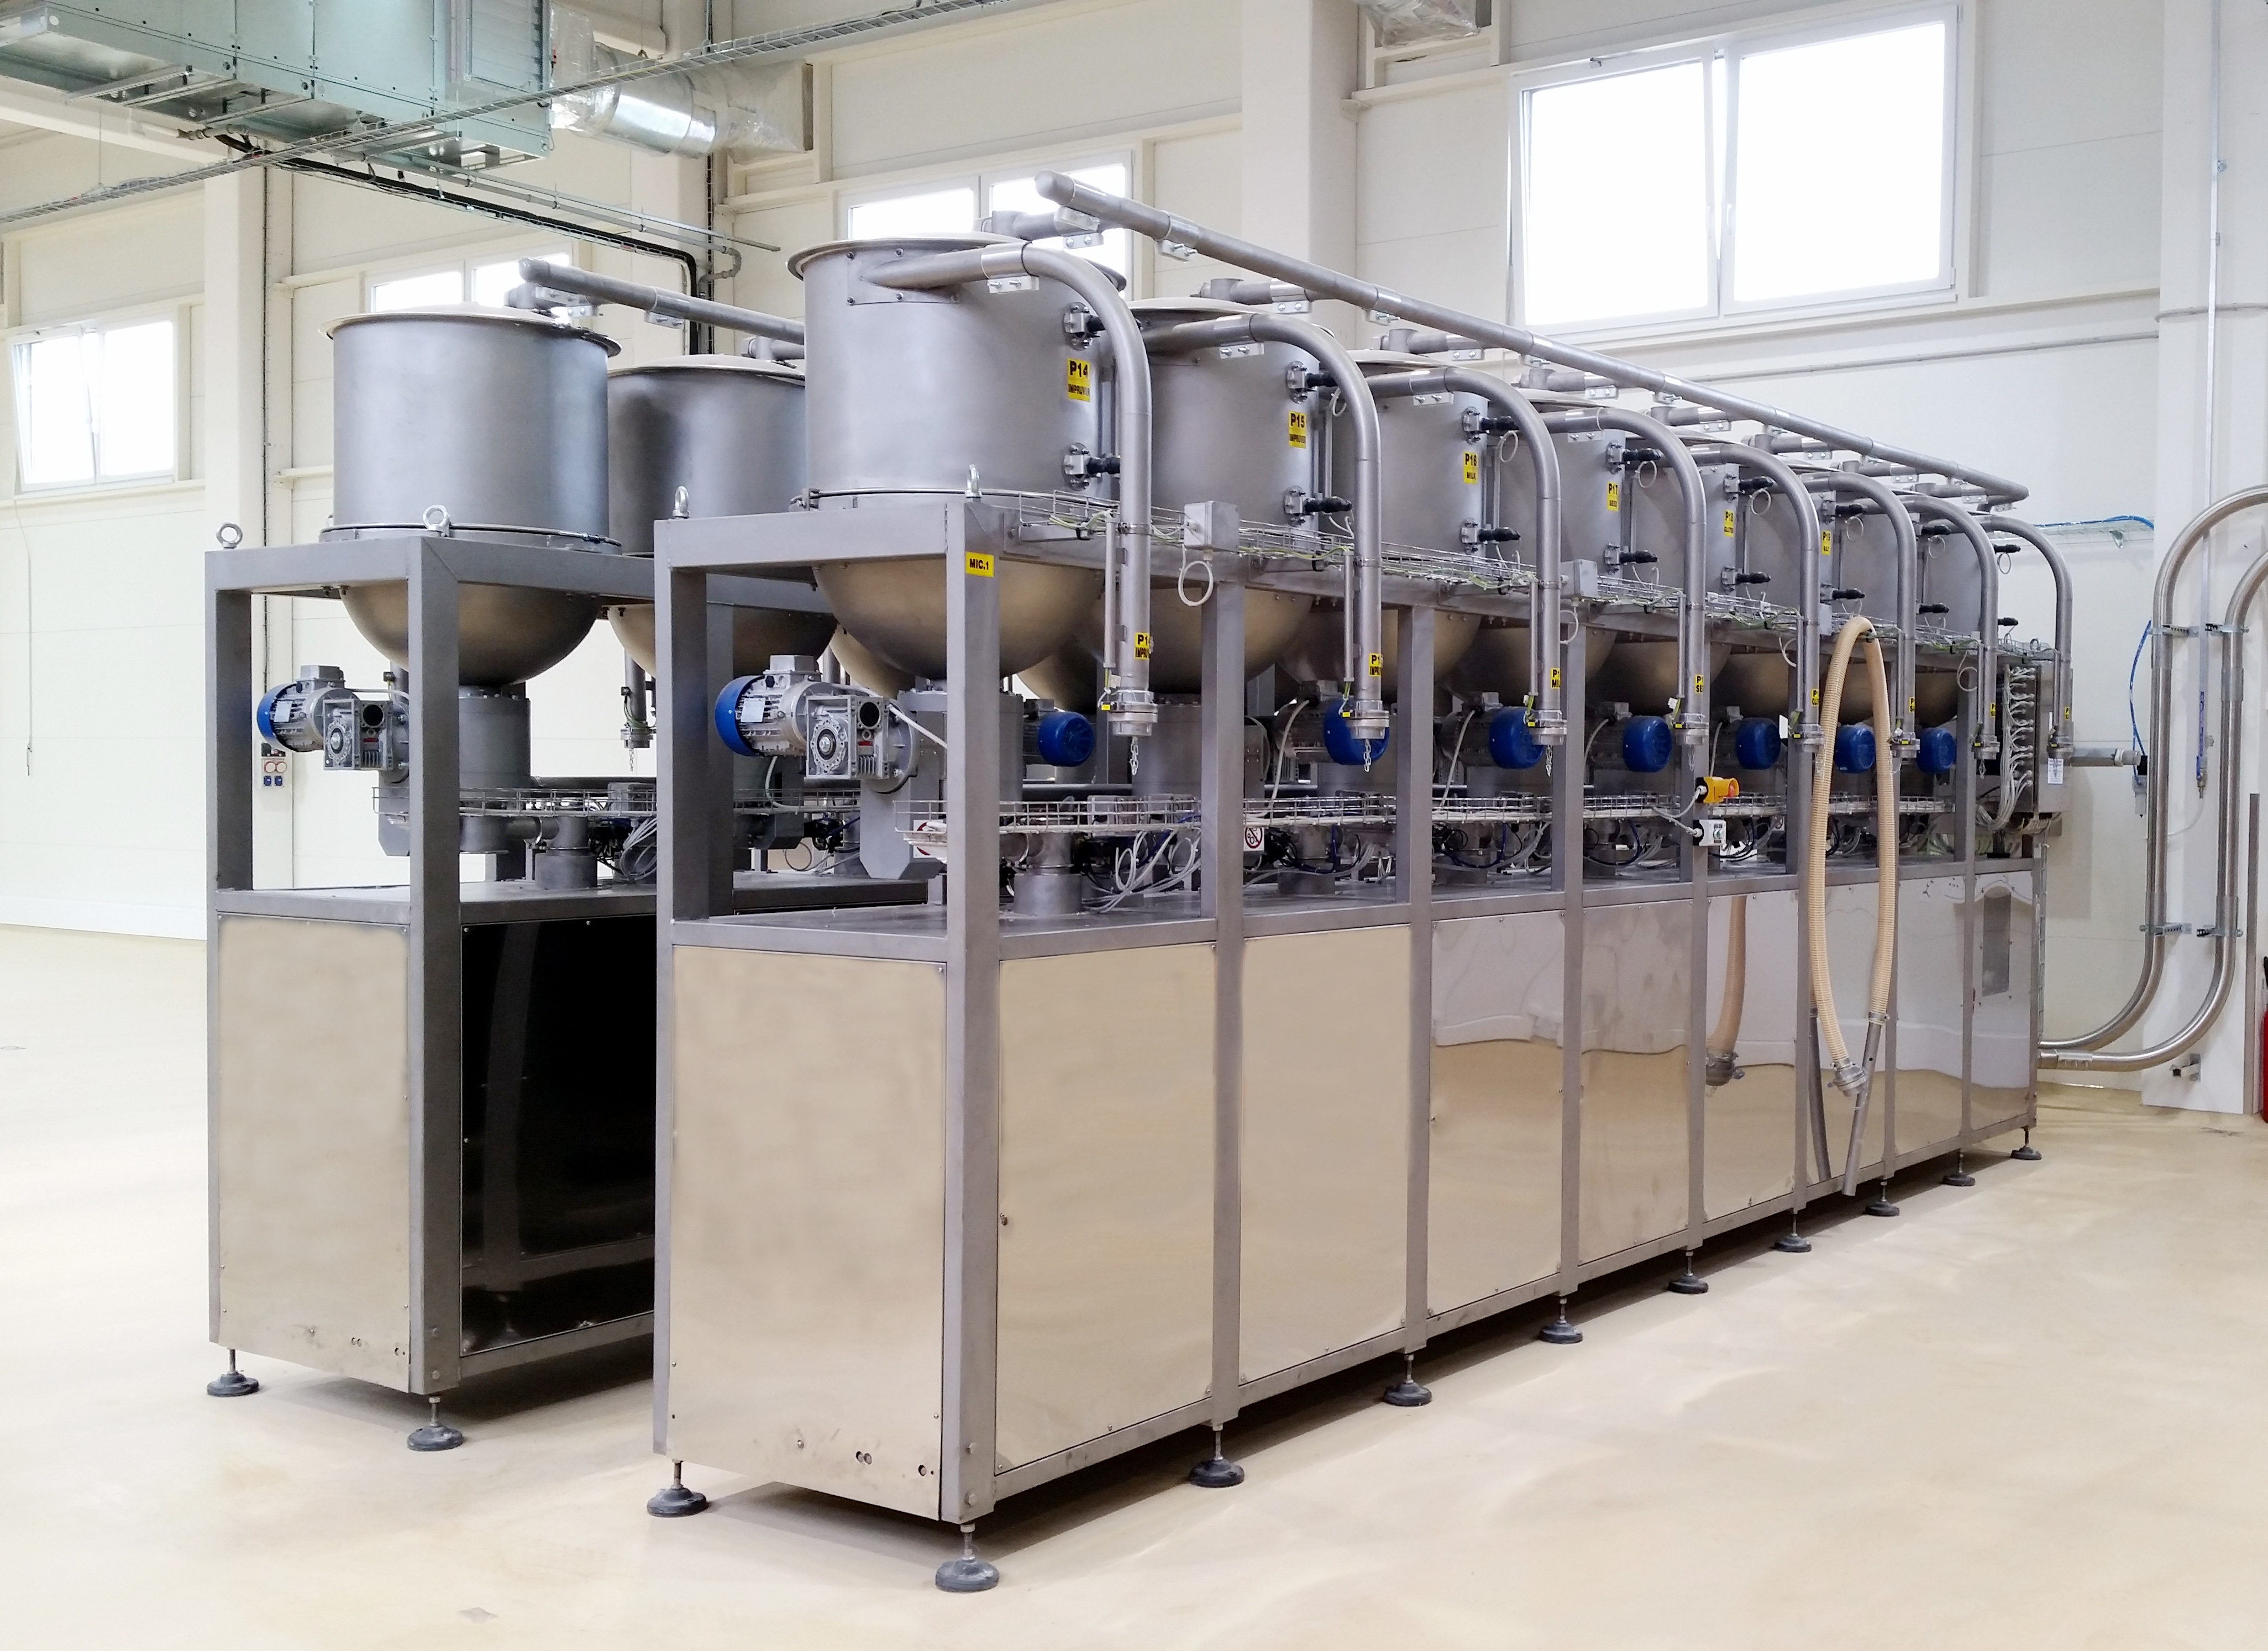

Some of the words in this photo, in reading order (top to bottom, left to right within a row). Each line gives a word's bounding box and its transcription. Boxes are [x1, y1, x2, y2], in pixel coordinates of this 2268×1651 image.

[1070, 360, 1088, 378] P14
[1290, 413, 1305, 428] P15
[1465, 453, 1477, 466] P16
[969, 558, 989, 570] MIC.1
